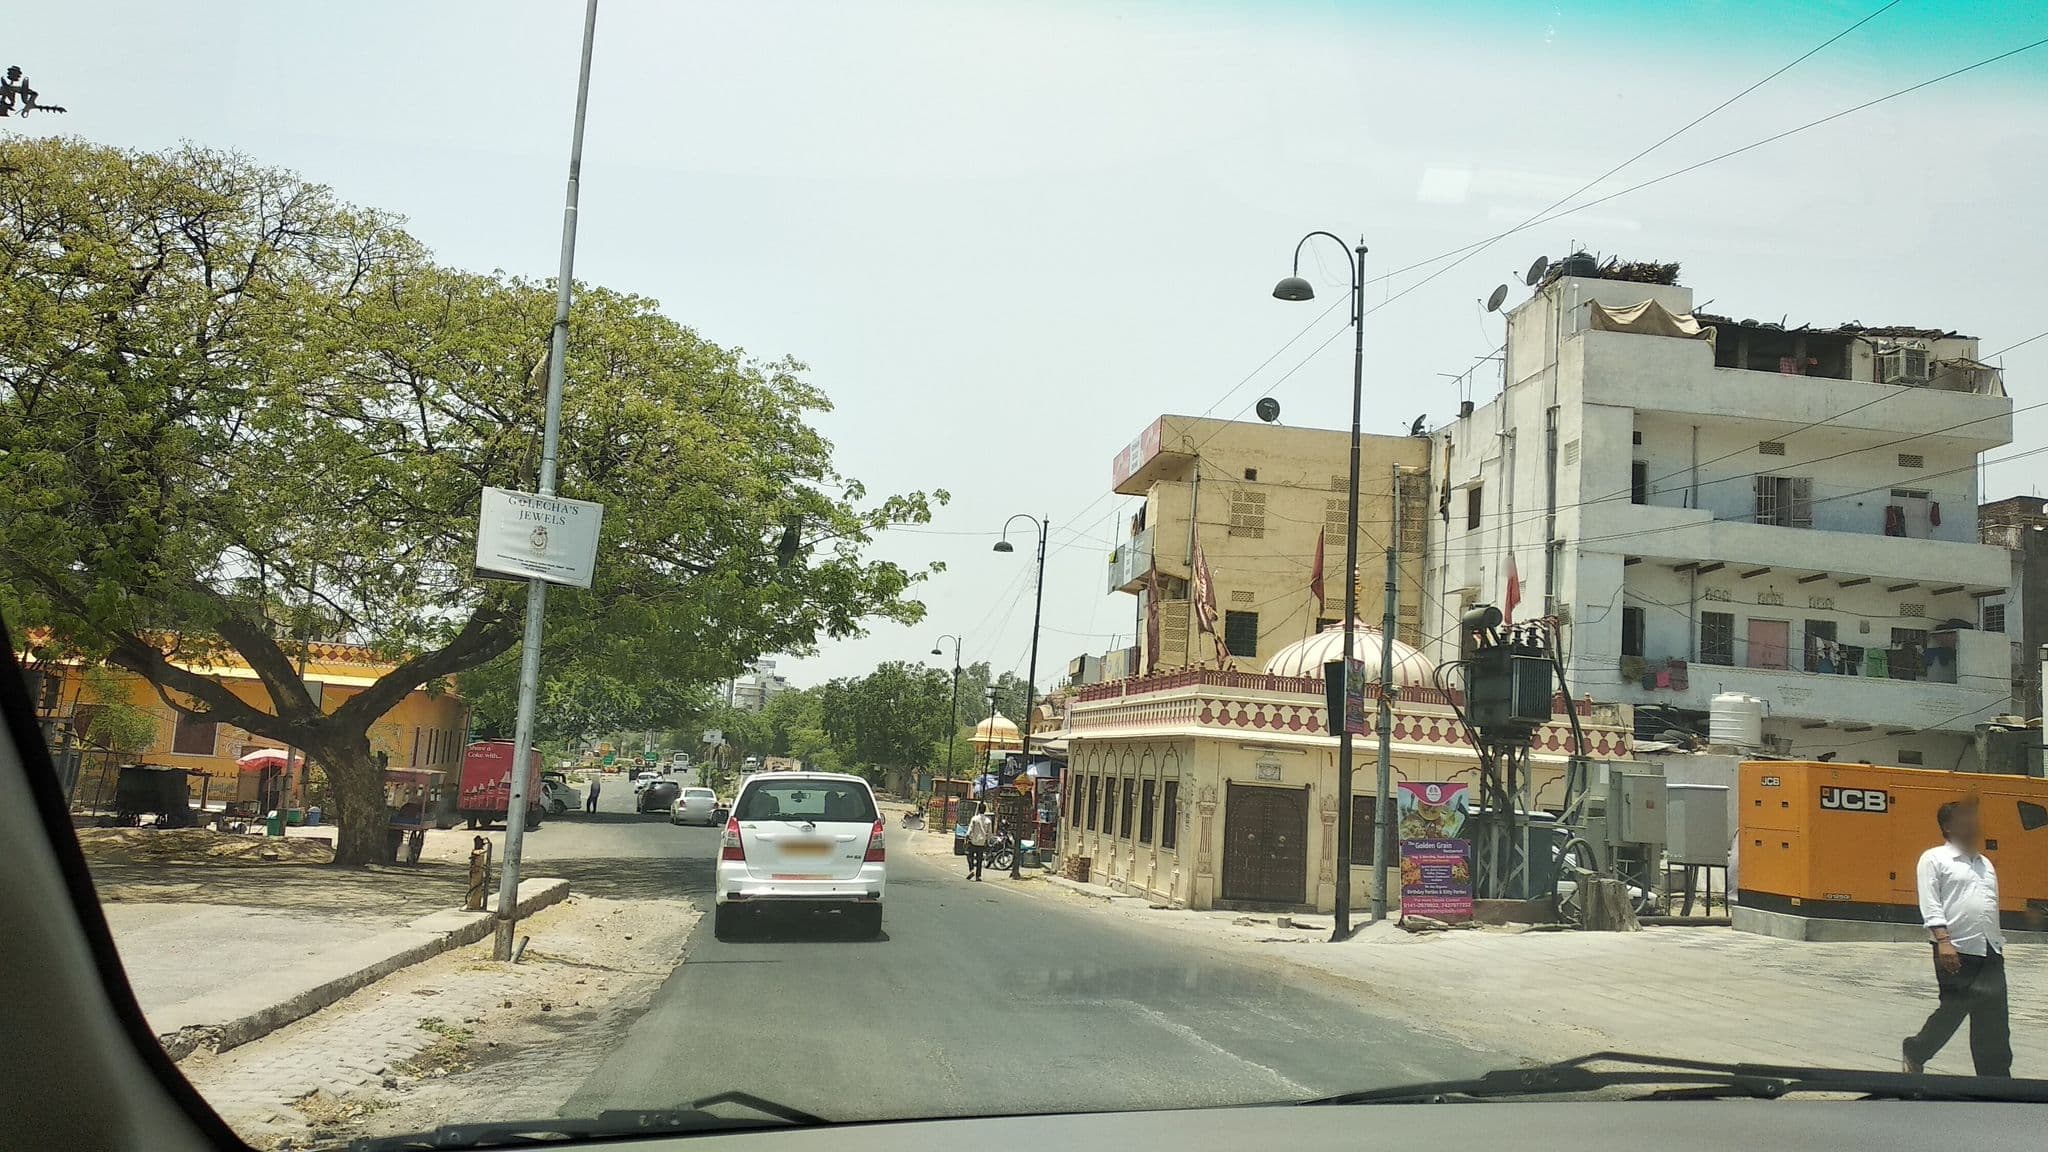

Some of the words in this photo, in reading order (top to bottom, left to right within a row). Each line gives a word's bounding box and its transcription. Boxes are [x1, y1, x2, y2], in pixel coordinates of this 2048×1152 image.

[508, 496, 579, 515] GOLECHA'S
[519, 510, 566, 525] JEWELS
[1761, 777, 1780, 786] JCB
[1822, 788, 1886, 811] JCB
